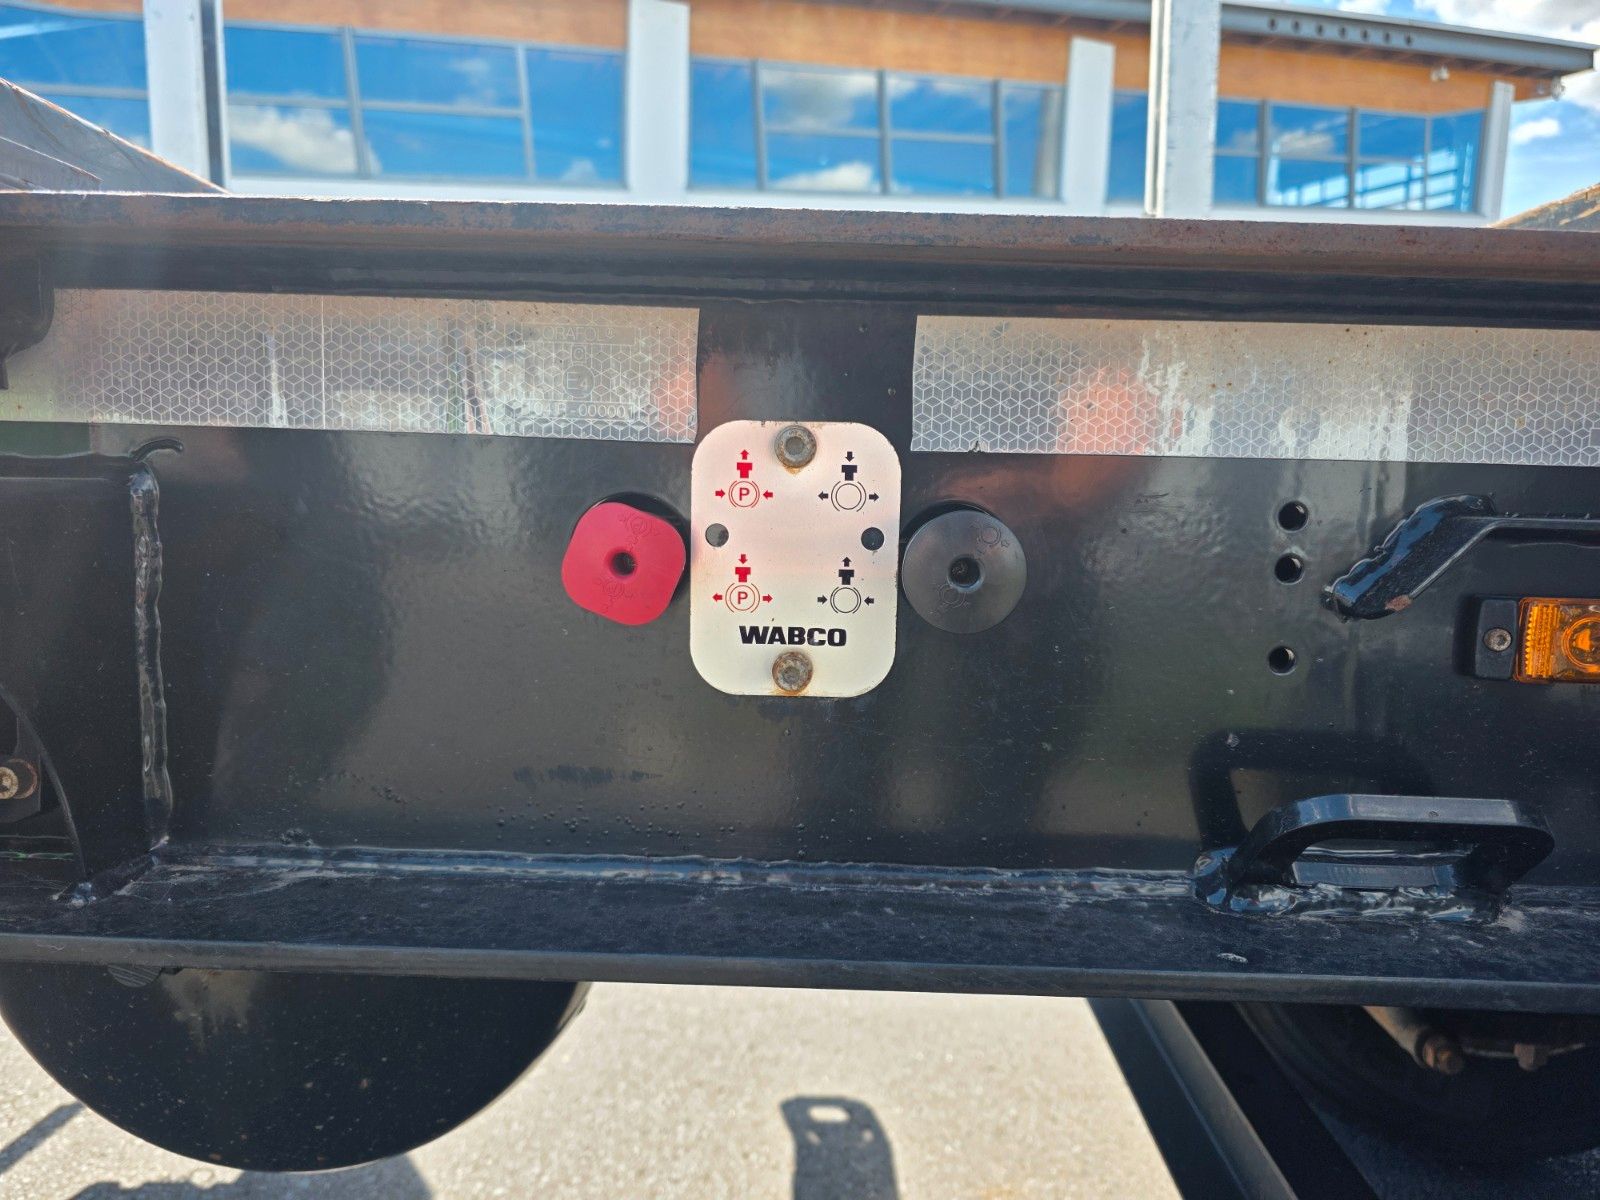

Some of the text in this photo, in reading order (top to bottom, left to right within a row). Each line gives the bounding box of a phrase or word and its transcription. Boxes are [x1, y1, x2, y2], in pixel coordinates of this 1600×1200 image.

[739, 487, 750, 501] P
[737, 591, 748, 604] P
[739, 625, 847, 647] WABCO
